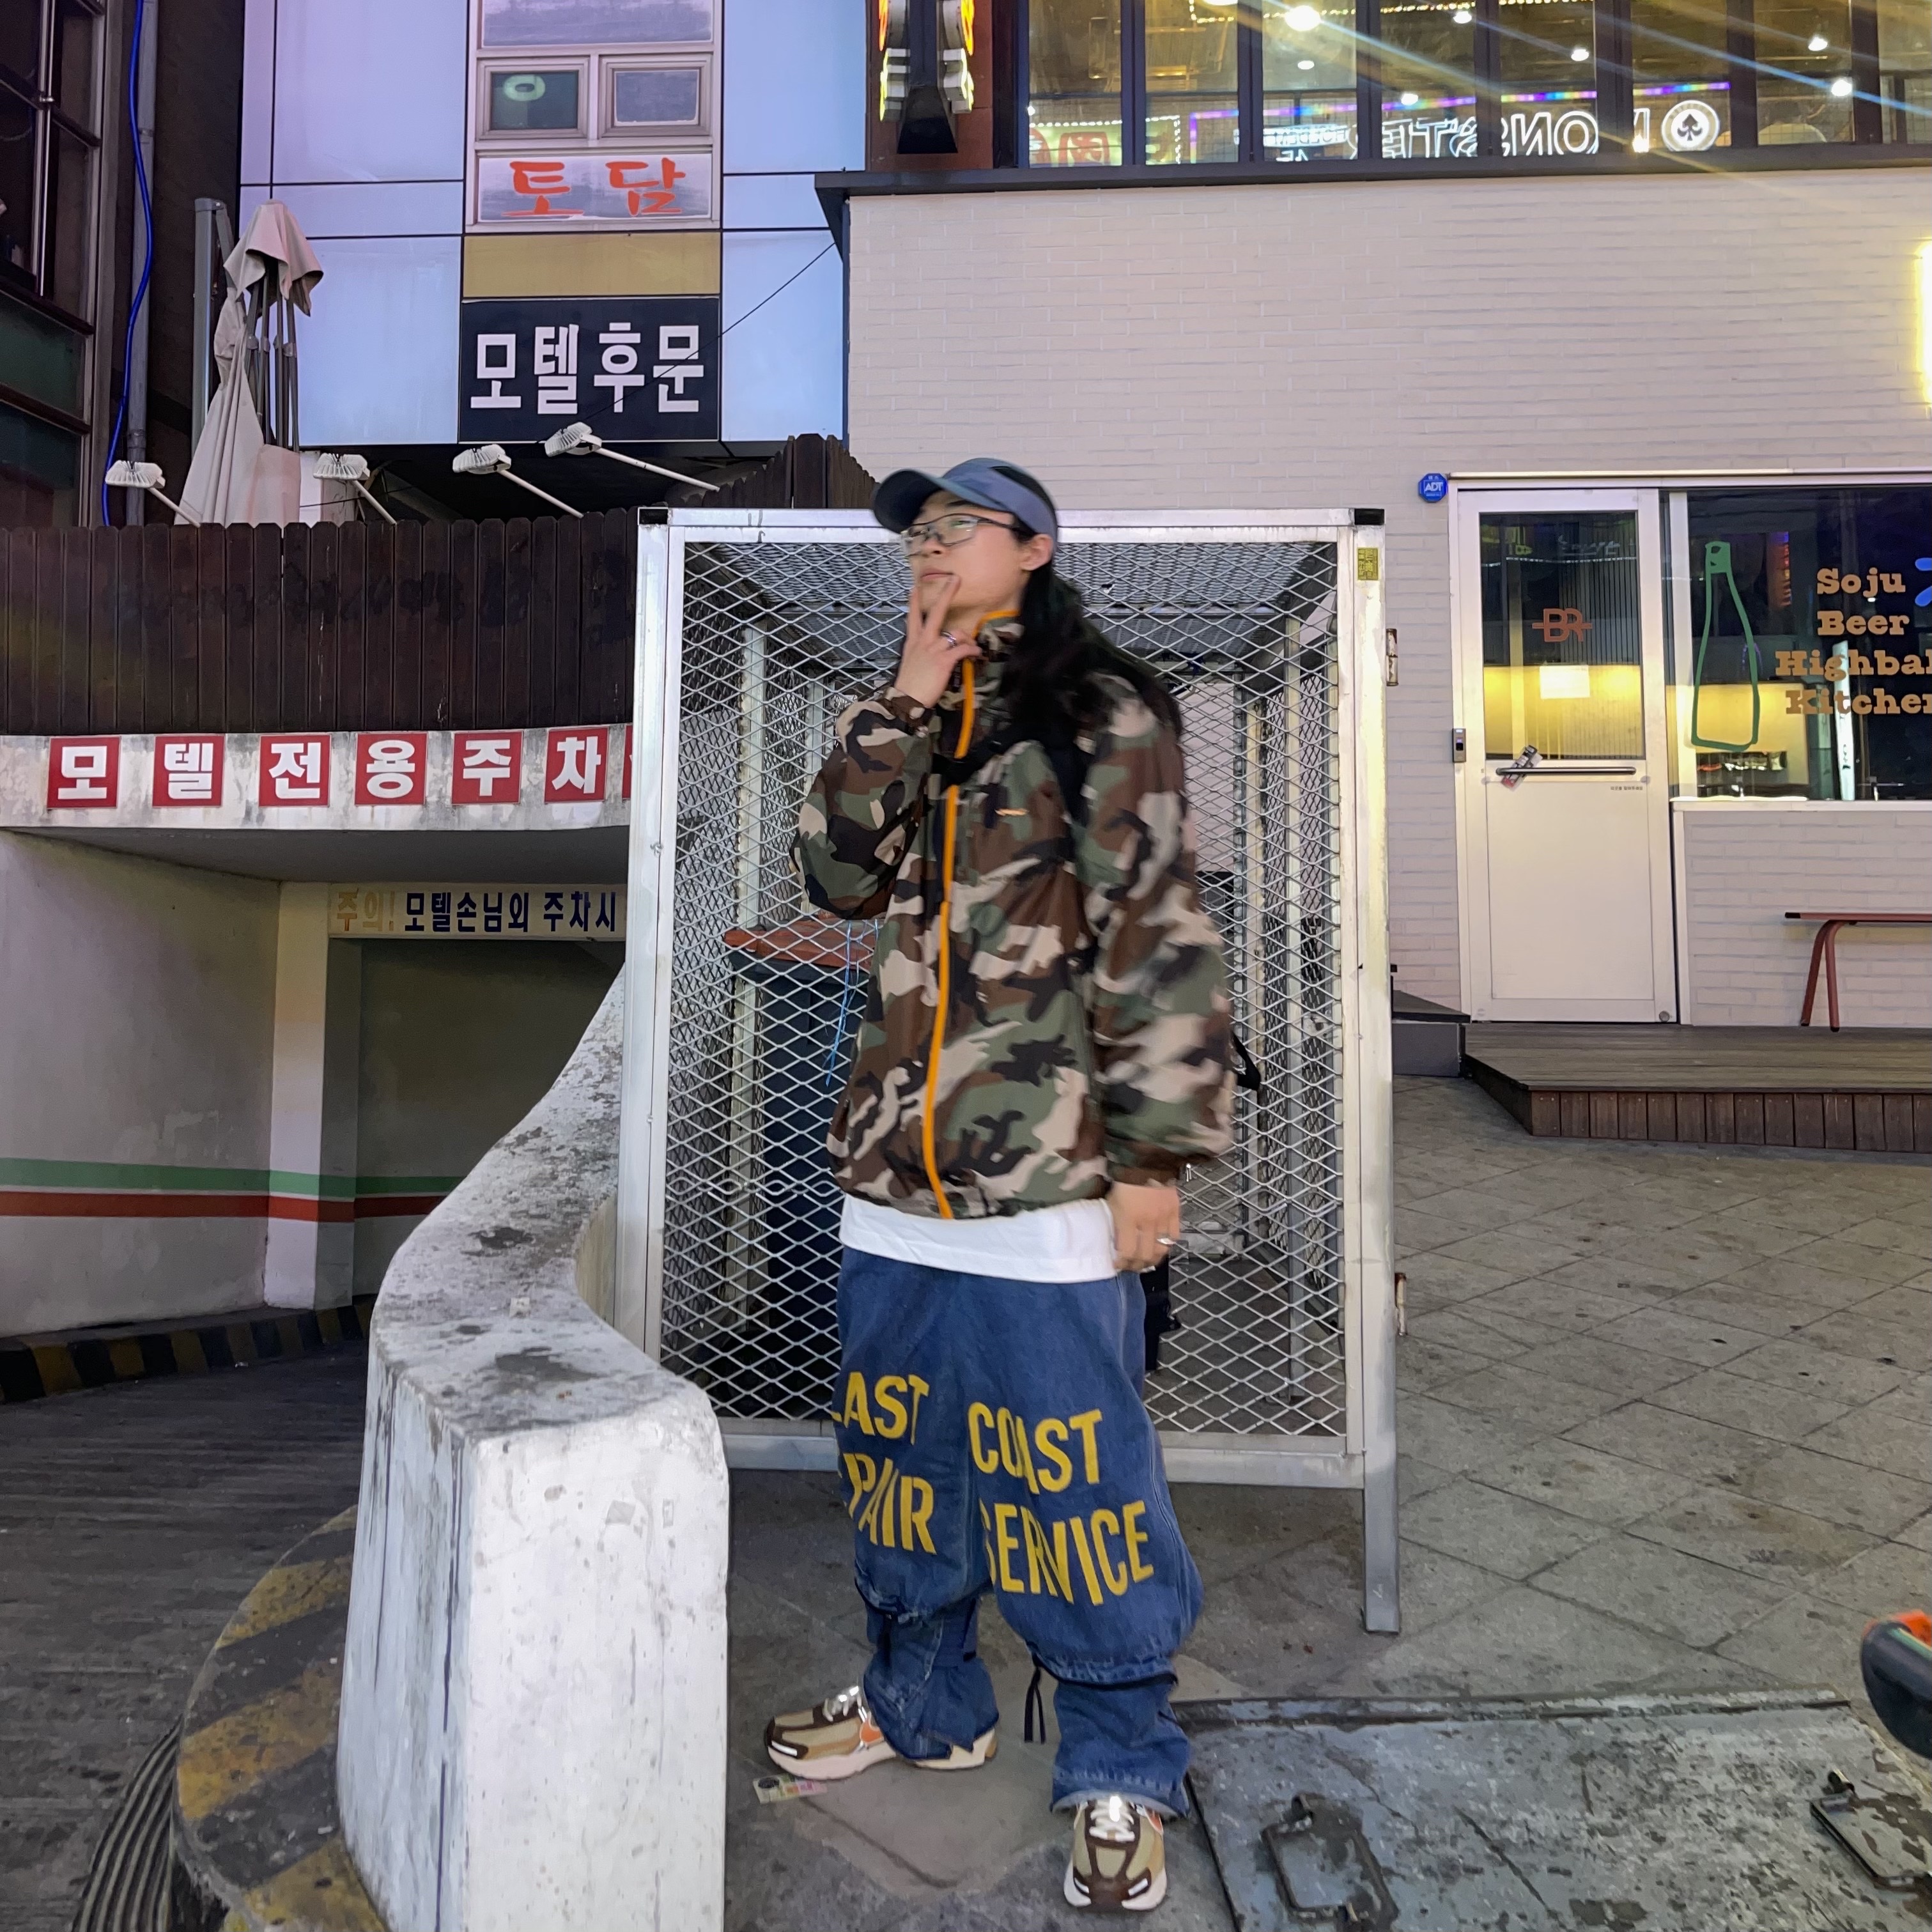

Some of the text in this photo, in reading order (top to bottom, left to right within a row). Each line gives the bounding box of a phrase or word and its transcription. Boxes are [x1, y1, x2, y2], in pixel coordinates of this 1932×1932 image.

[470, 321, 704, 415] 모텔후문
[1425, 482, 1443, 491] ADT
[1816, 567, 1906, 598] Soju
[1816, 610, 1910, 636] Beer
[57, 736, 633, 801] 모텔전용주차
[405, 892, 529, 932] 모텔손님외
[543, 891, 616, 932] 주차시
[832, 1371, 929, 1446] AST
